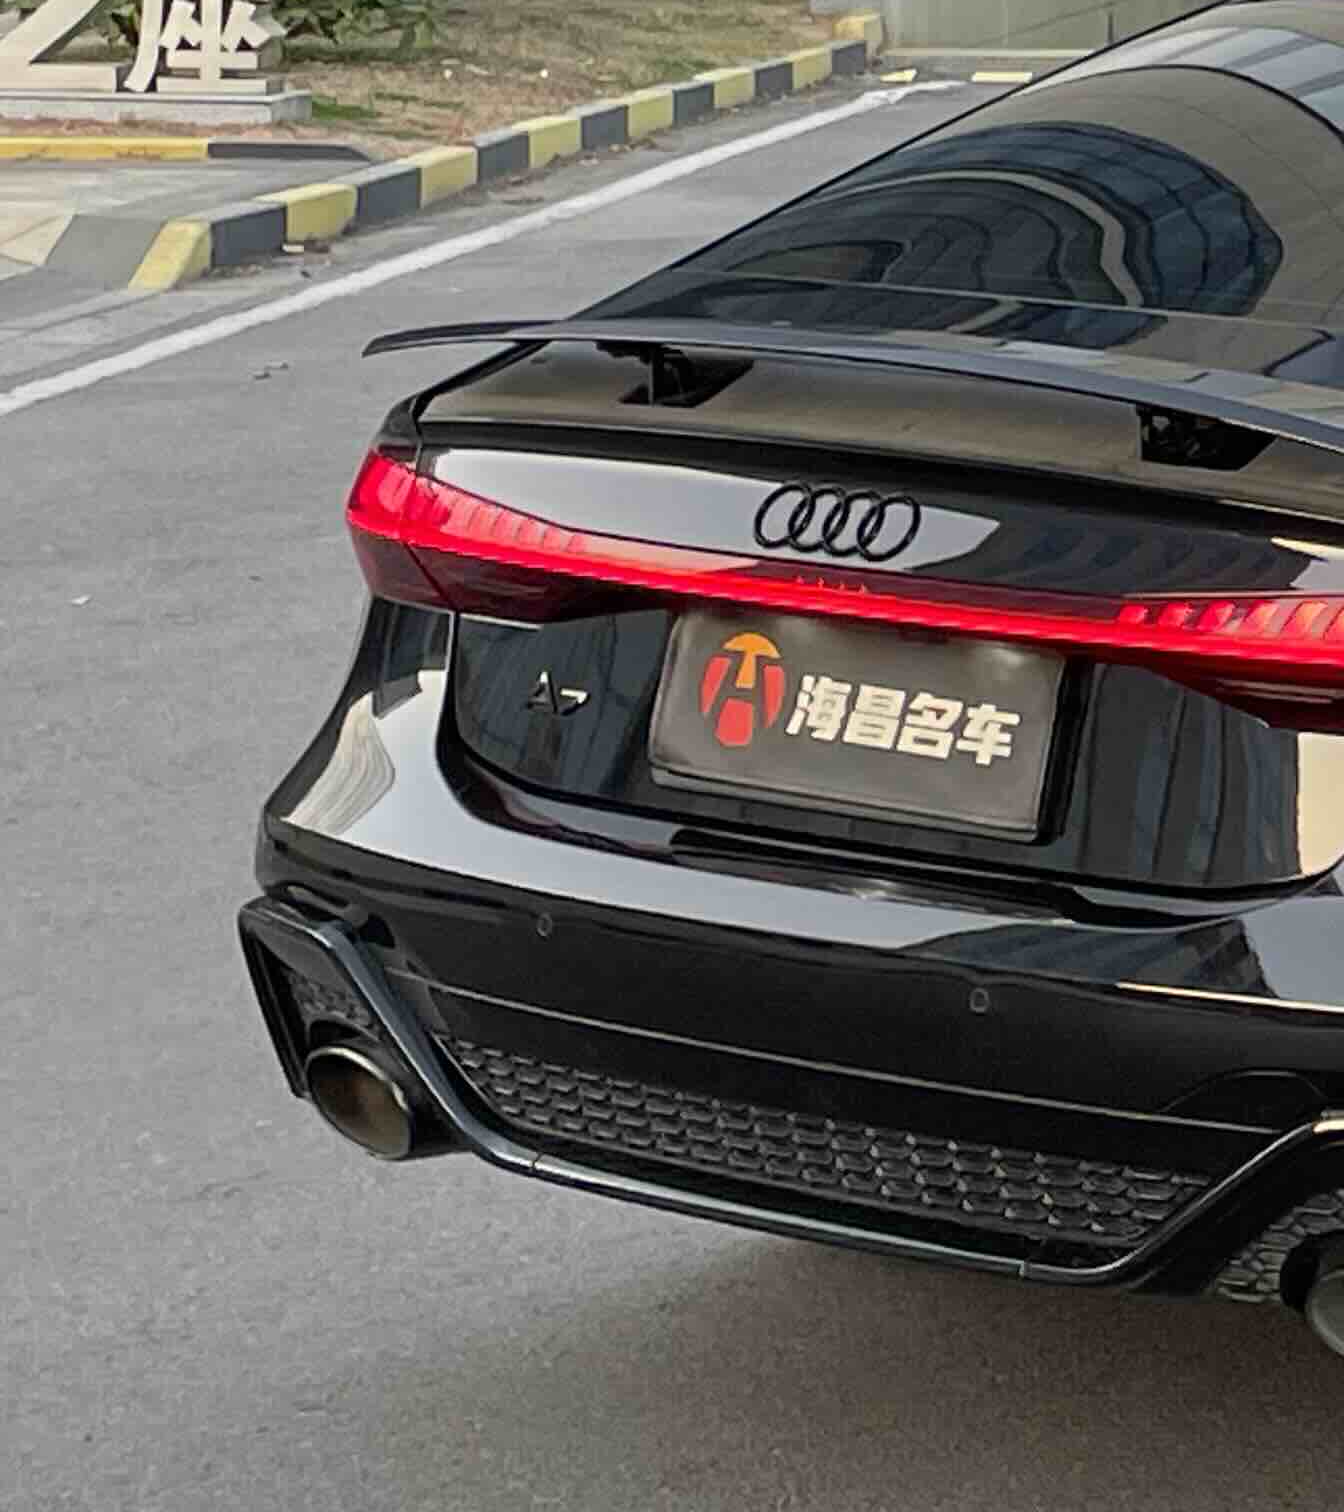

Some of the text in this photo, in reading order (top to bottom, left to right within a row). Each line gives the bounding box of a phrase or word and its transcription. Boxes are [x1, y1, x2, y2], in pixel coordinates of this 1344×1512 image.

[525, 671, 590, 716] A7
[785, 675, 1020, 765] 海昌名车
